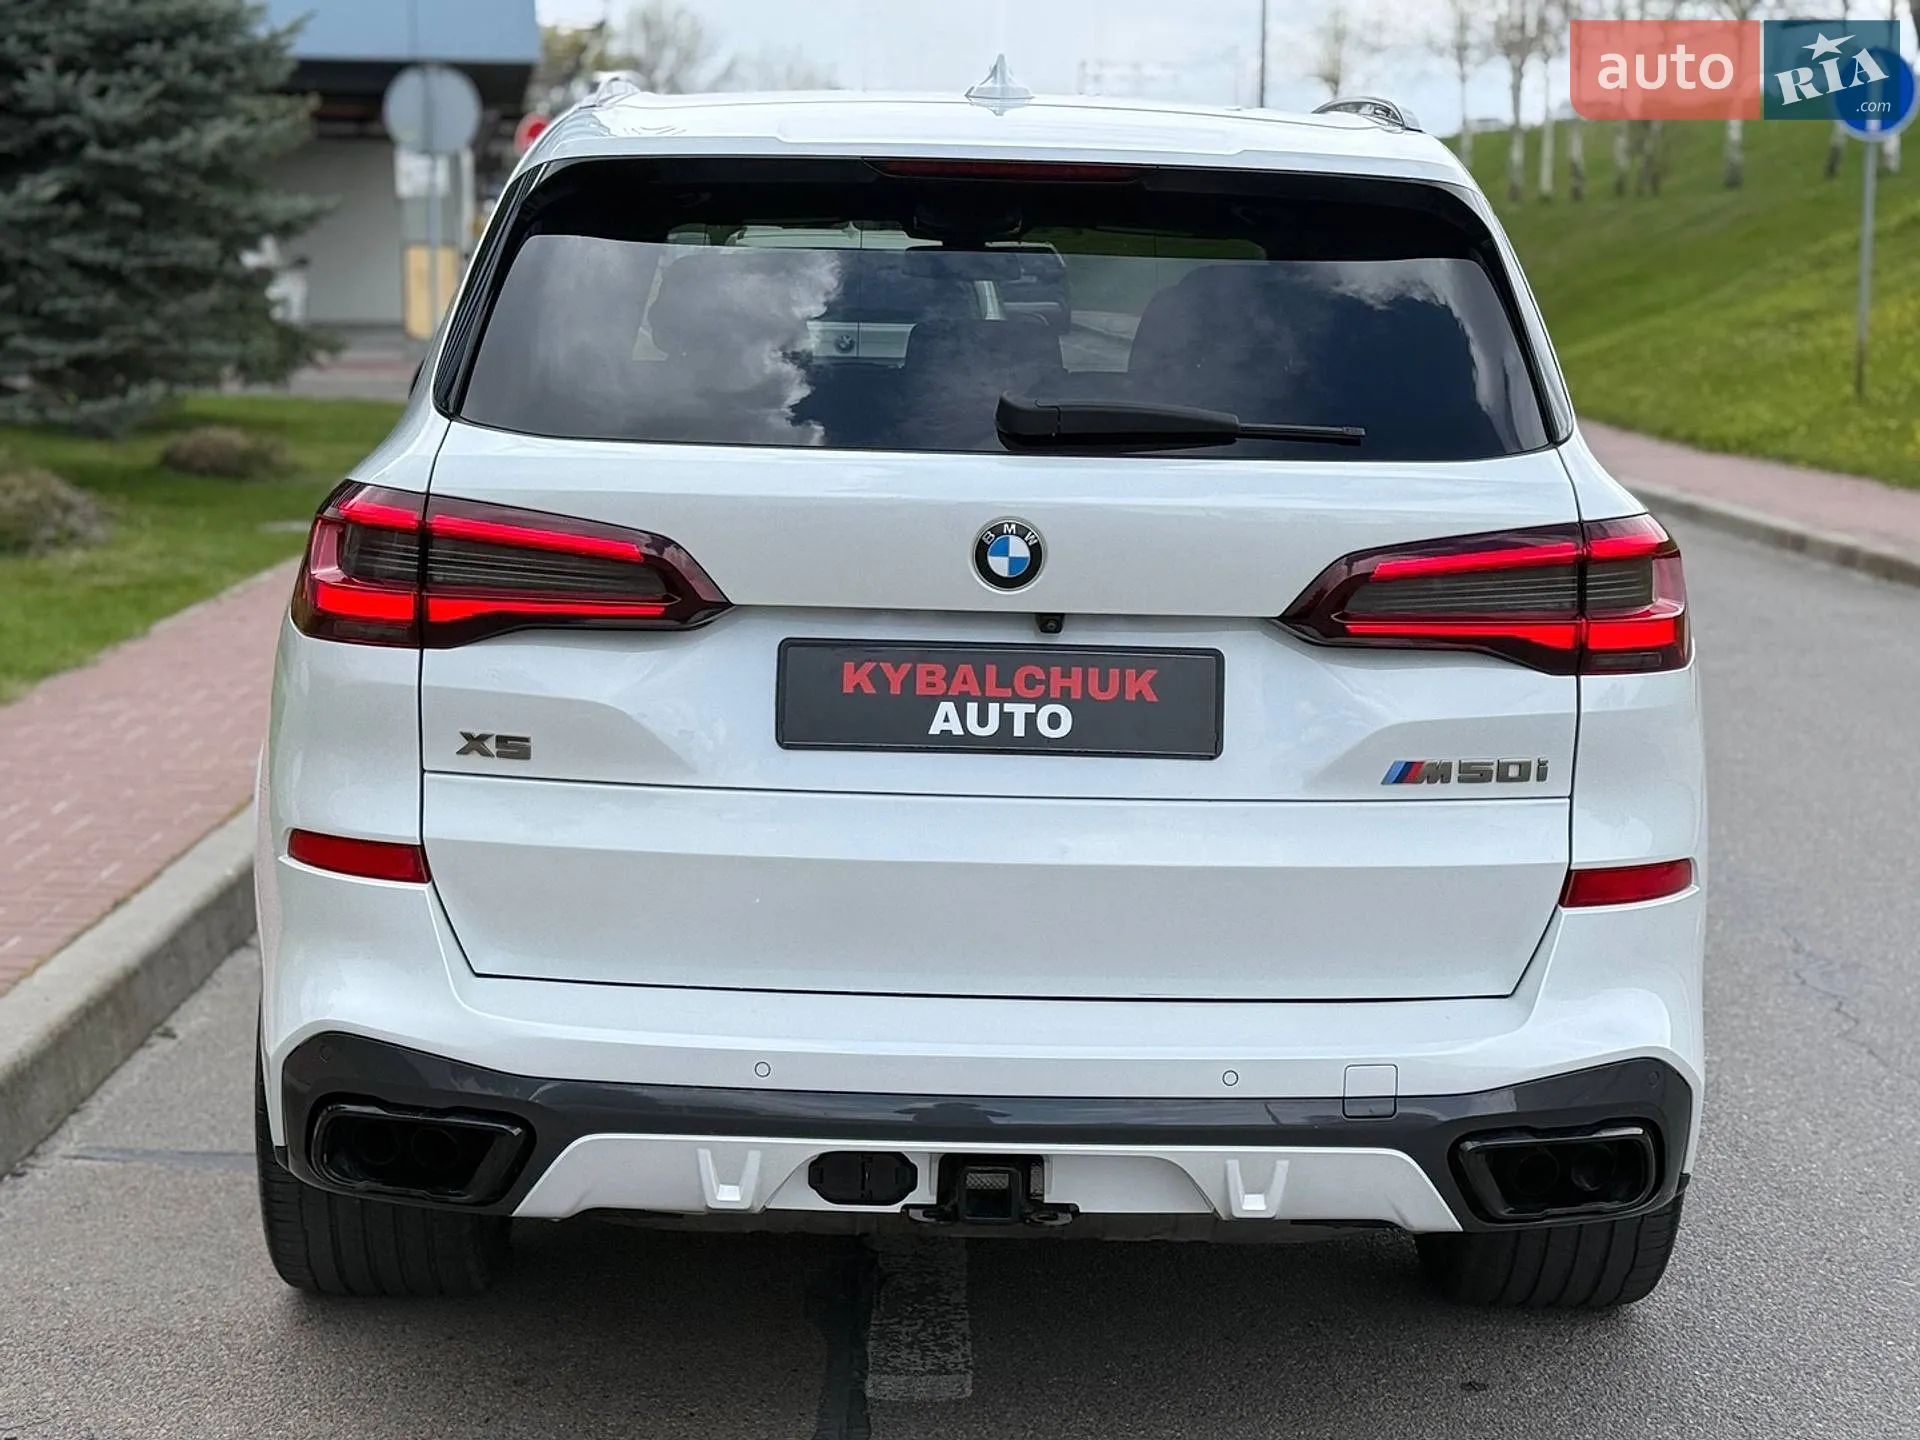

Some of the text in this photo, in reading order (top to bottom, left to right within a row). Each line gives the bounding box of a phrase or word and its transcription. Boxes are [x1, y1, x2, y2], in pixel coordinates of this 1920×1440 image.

[981, 523, 1038, 546] BMW
[842, 661, 1158, 702] KYBALCHUK
[928, 701, 1073, 739] AUTO
[455, 731, 532, 761] X5
[1410, 756, 1549, 785] M50i
